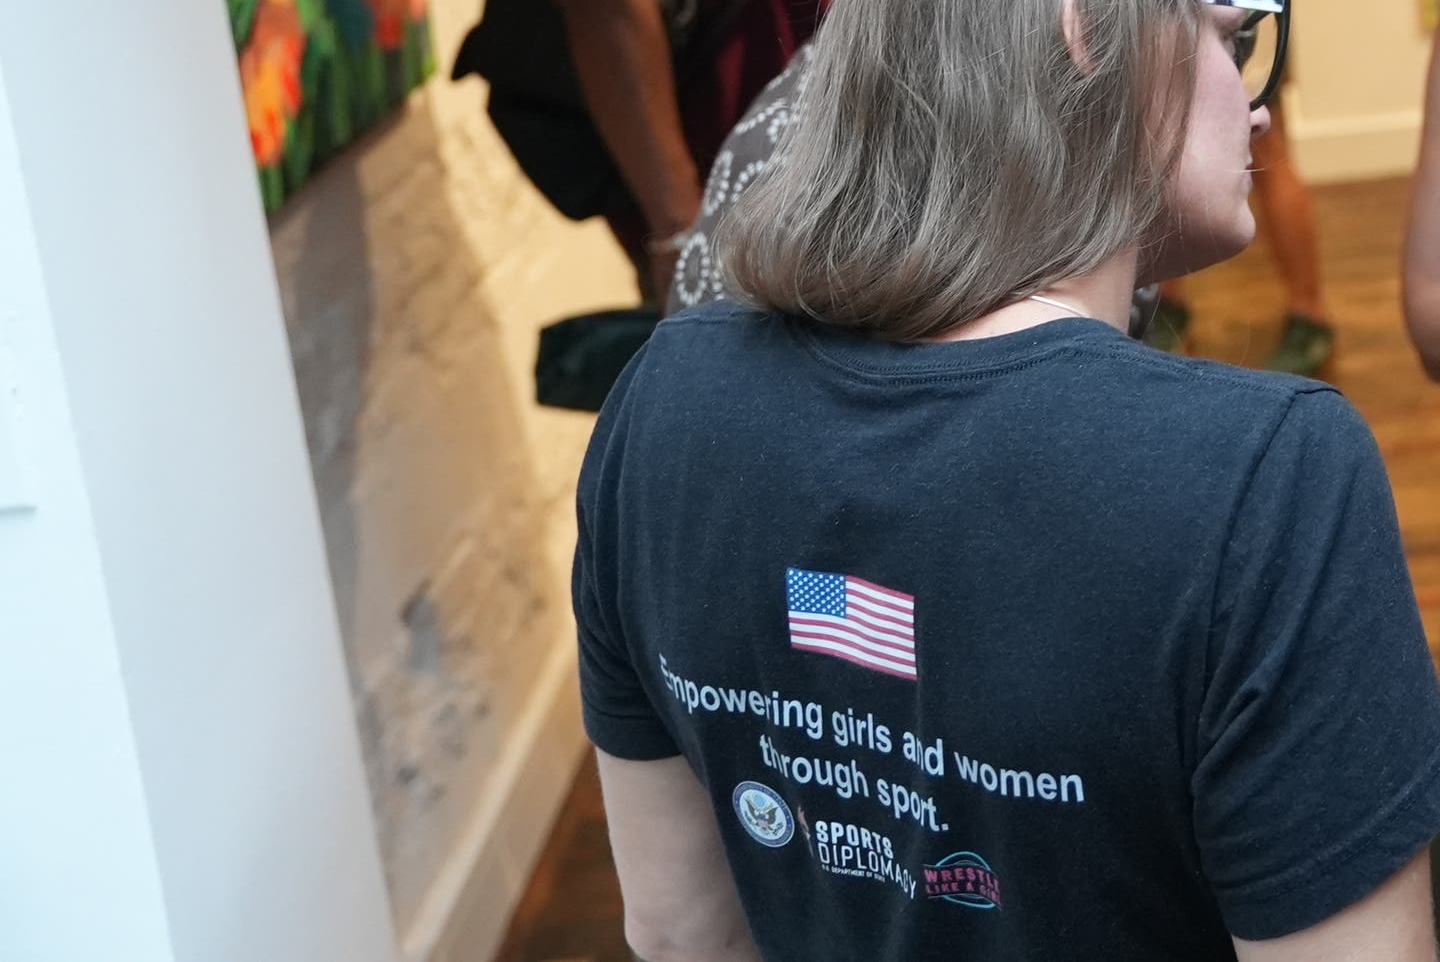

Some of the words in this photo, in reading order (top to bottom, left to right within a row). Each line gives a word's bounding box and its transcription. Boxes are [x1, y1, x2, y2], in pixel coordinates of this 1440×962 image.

[659, 653, 823, 739] Empowering
[832, 708, 892, 754] girls
[902, 731, 944, 776] and
[954, 751, 1084, 802] women
[760, 734, 869, 798] through
[877, 778, 949, 831] sport.
[815, 820, 894, 859] SPORTS
[818, 843, 917, 899] DIPLOMACY
[925, 882, 960, 894] LIKE
[966, 881, 975, 892] A
